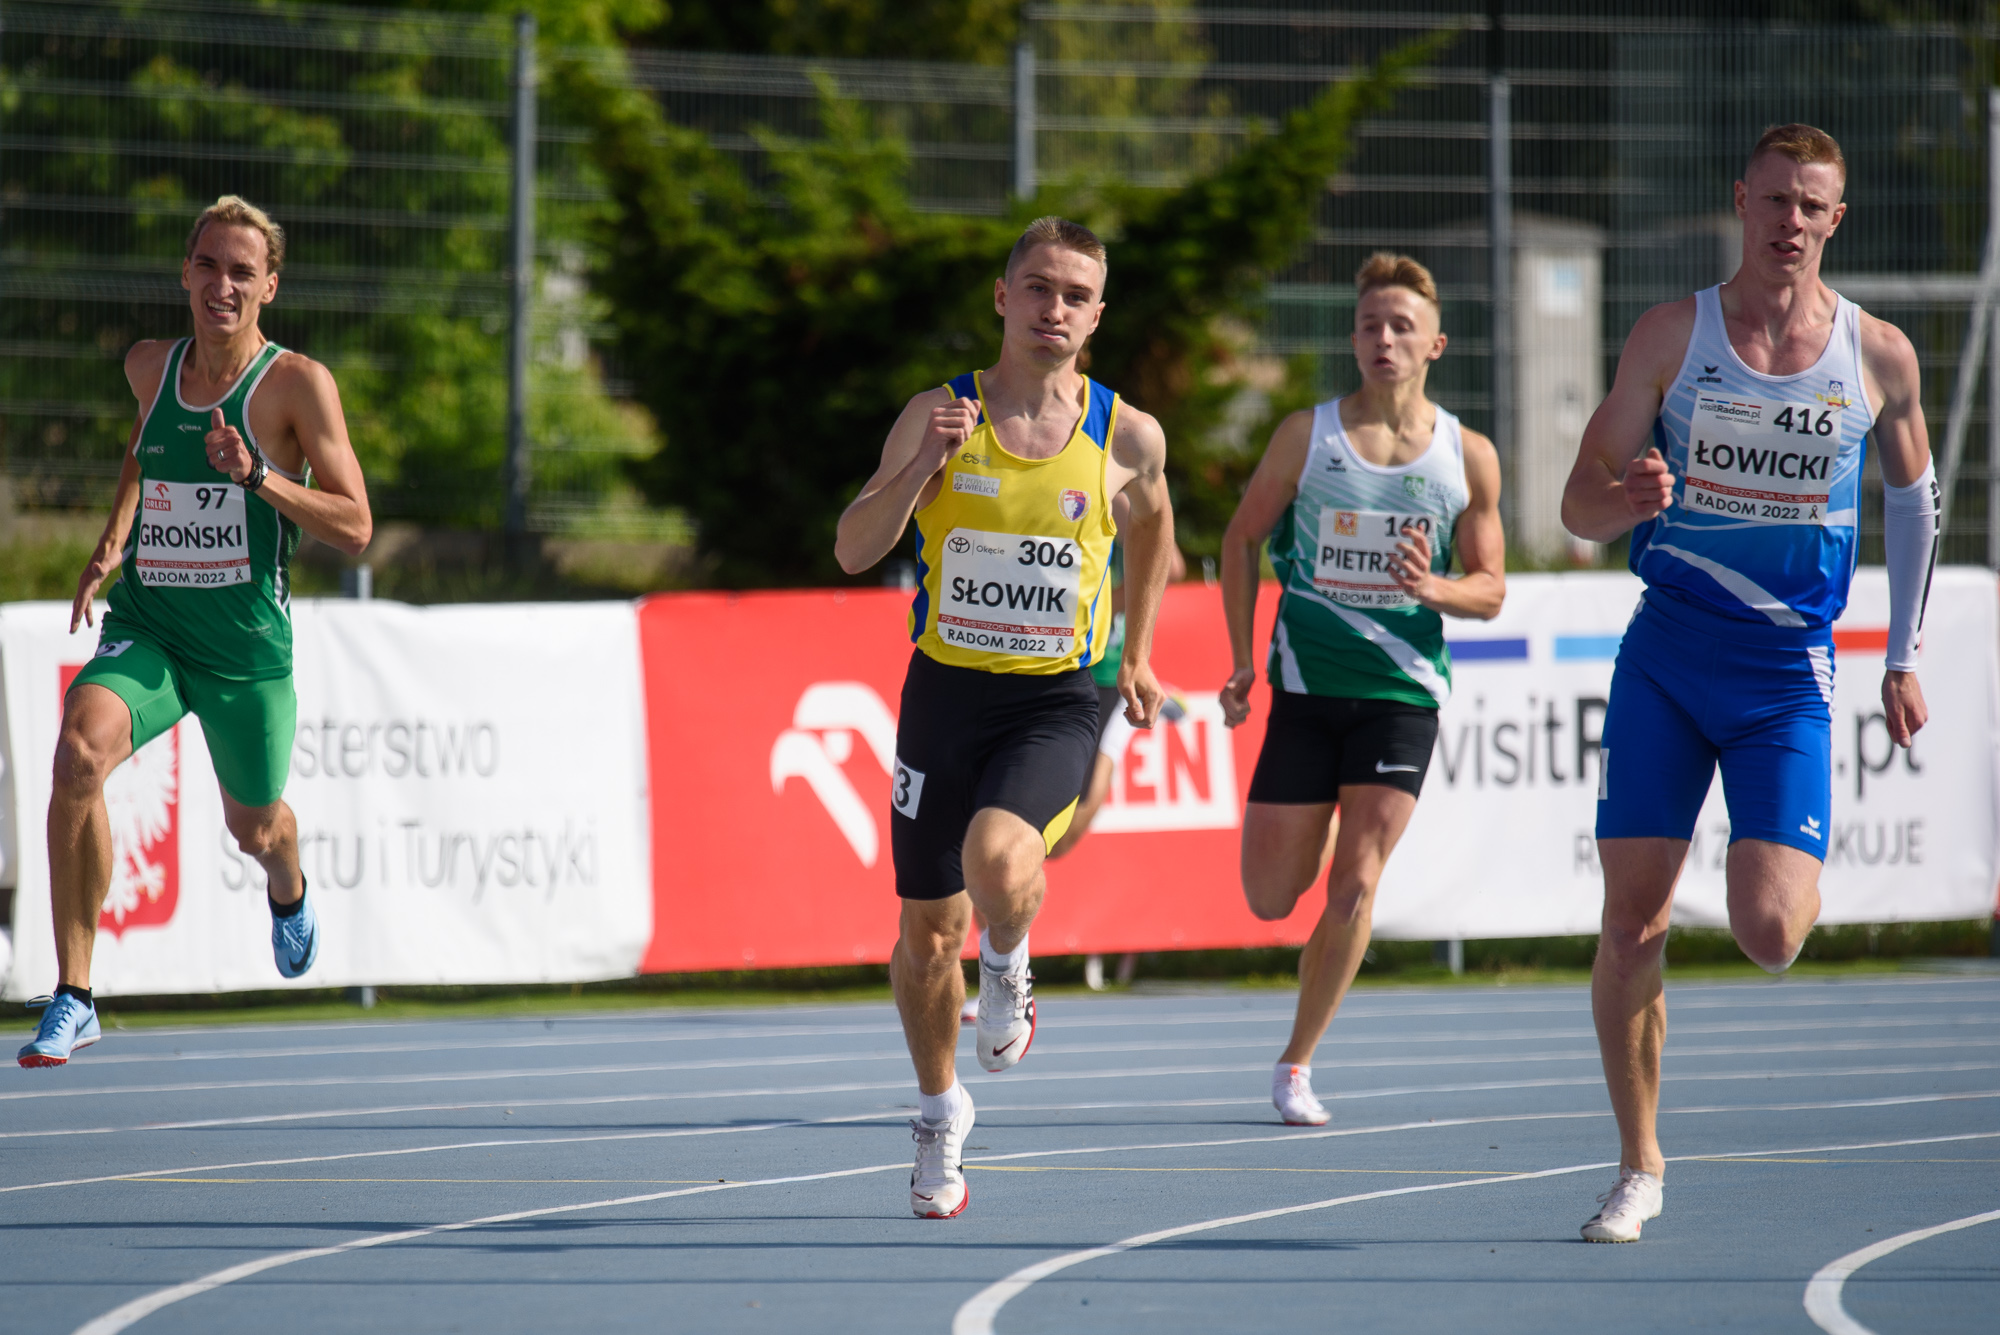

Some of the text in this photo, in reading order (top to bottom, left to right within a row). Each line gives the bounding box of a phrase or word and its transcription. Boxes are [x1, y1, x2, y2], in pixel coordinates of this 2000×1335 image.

[1699, 403, 1762, 419] visitRadom.pl
[1773, 406, 1833, 437] 416
[1694, 439, 1830, 480] ŁOWICKI
[964, 483, 999, 495] WIELICKI
[965, 477, 997, 488] POWIAT
[1690, 478, 1827, 503] PZLA MISTRZOSTWA POLSKI U20
[145, 500, 170, 511] ORLEN
[195, 487, 228, 510] 97
[1695, 492, 1800, 519] RADOM 2022
[140, 521, 243, 549] GROŃSKI
[976, 544, 1005, 555] Okęcie
[1017, 540, 1074, 568] 306
[141, 570, 226, 584] RADOM 2022
[153, 561, 203, 569] MISTRZOSTWA
[203, 561, 230, 569] POLSKI
[951, 576, 1067, 613] SŁOWIK
[941, 615, 1072, 636] PZLA MISTRZOSTWA POLSKI U20
[947, 628, 1046, 652] RADOM 2022
[293, 715, 499, 778] sterstwo
[895, 767, 911, 808] 3
[377, 816, 389, 888] i
[397, 815, 599, 905] Turystyki
